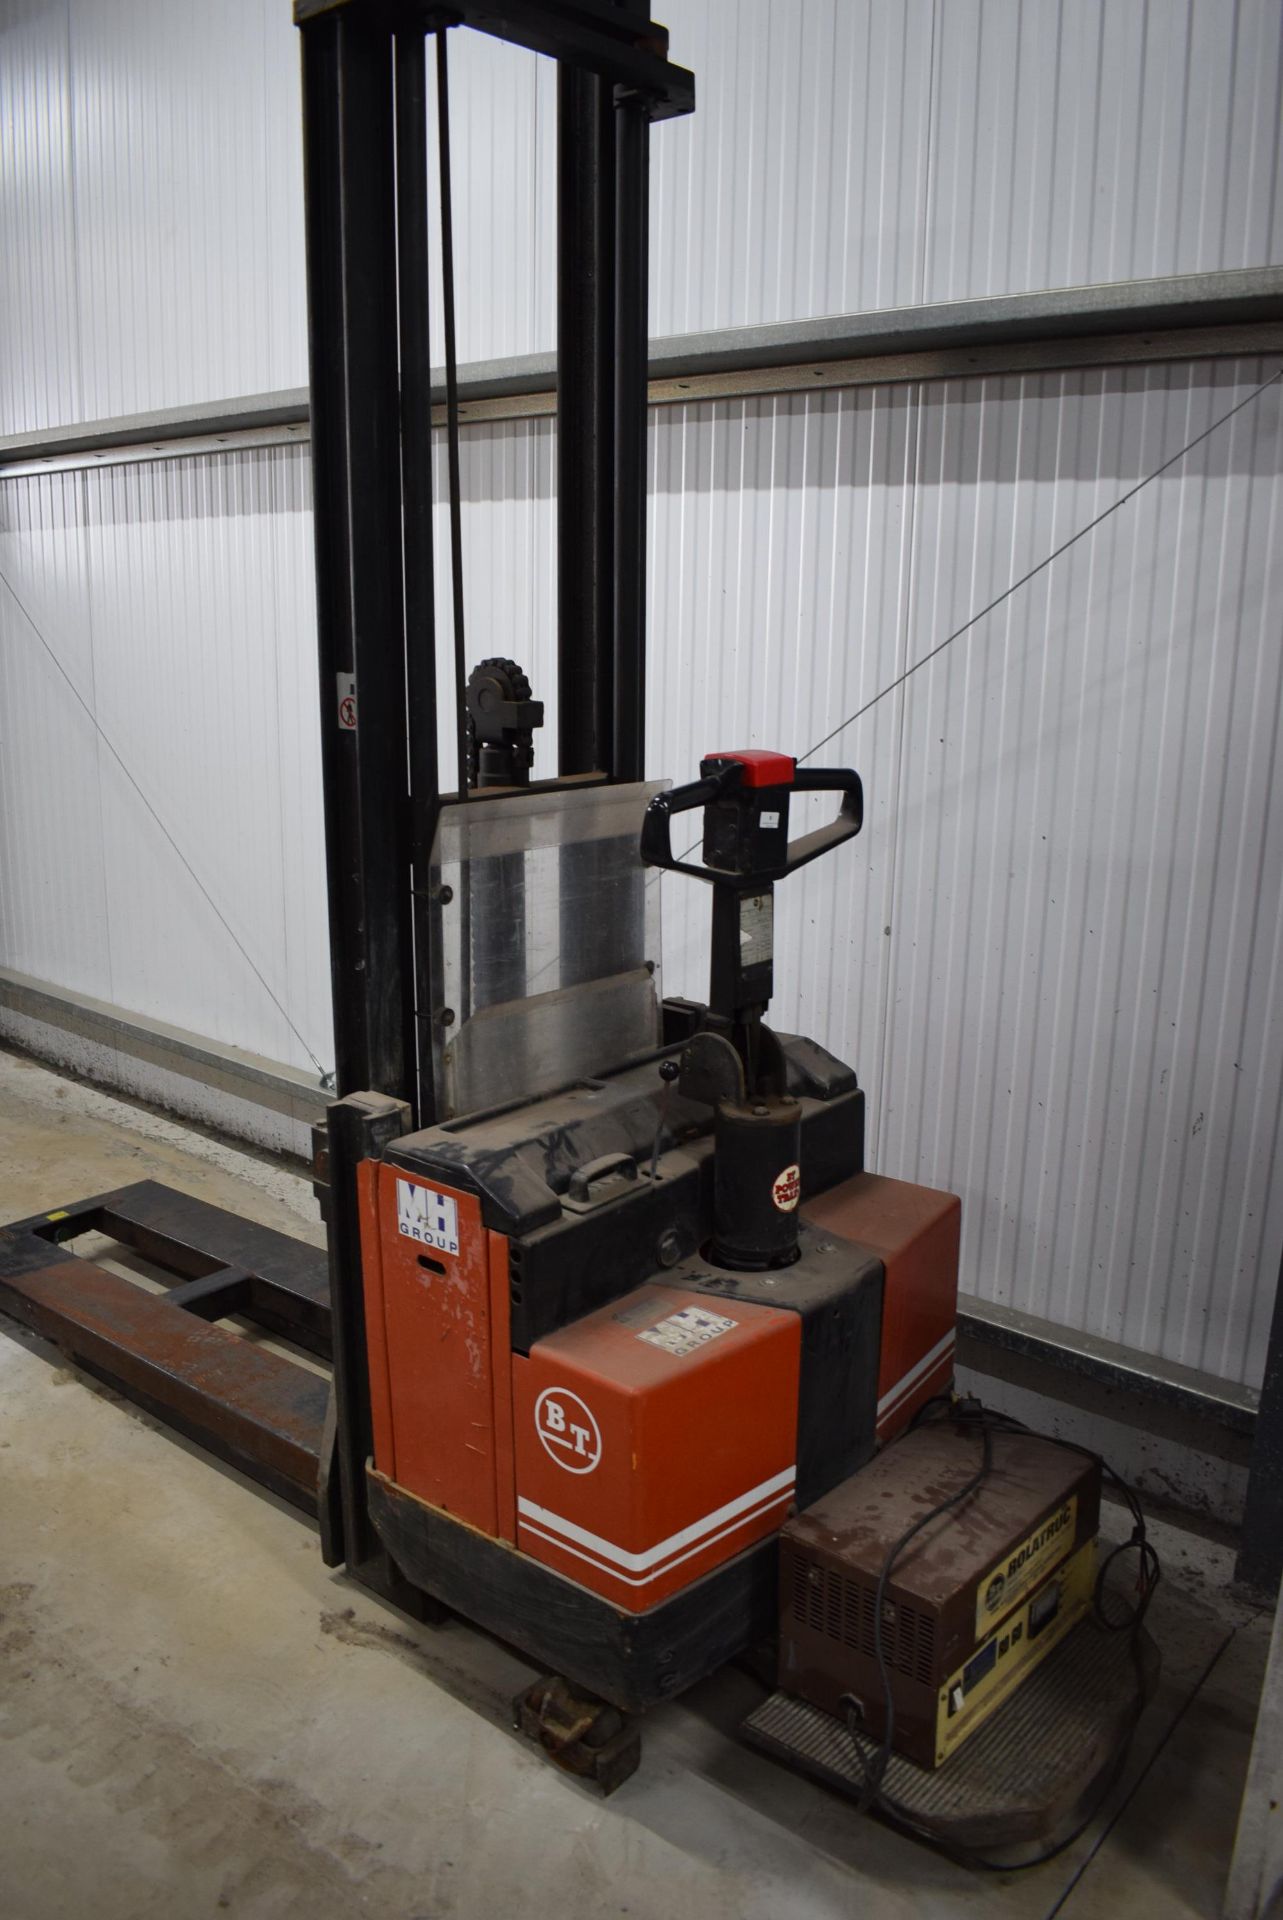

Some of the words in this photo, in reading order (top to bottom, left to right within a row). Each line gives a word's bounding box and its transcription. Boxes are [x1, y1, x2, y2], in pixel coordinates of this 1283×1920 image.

[398, 1180, 457, 1235] MH
[400, 1222, 457, 1252] GROUP
[675, 1319, 733, 1355] GROUP
[545, 1399, 590, 1456] BT
[1008, 1504, 1071, 1577] ROLATRUC
